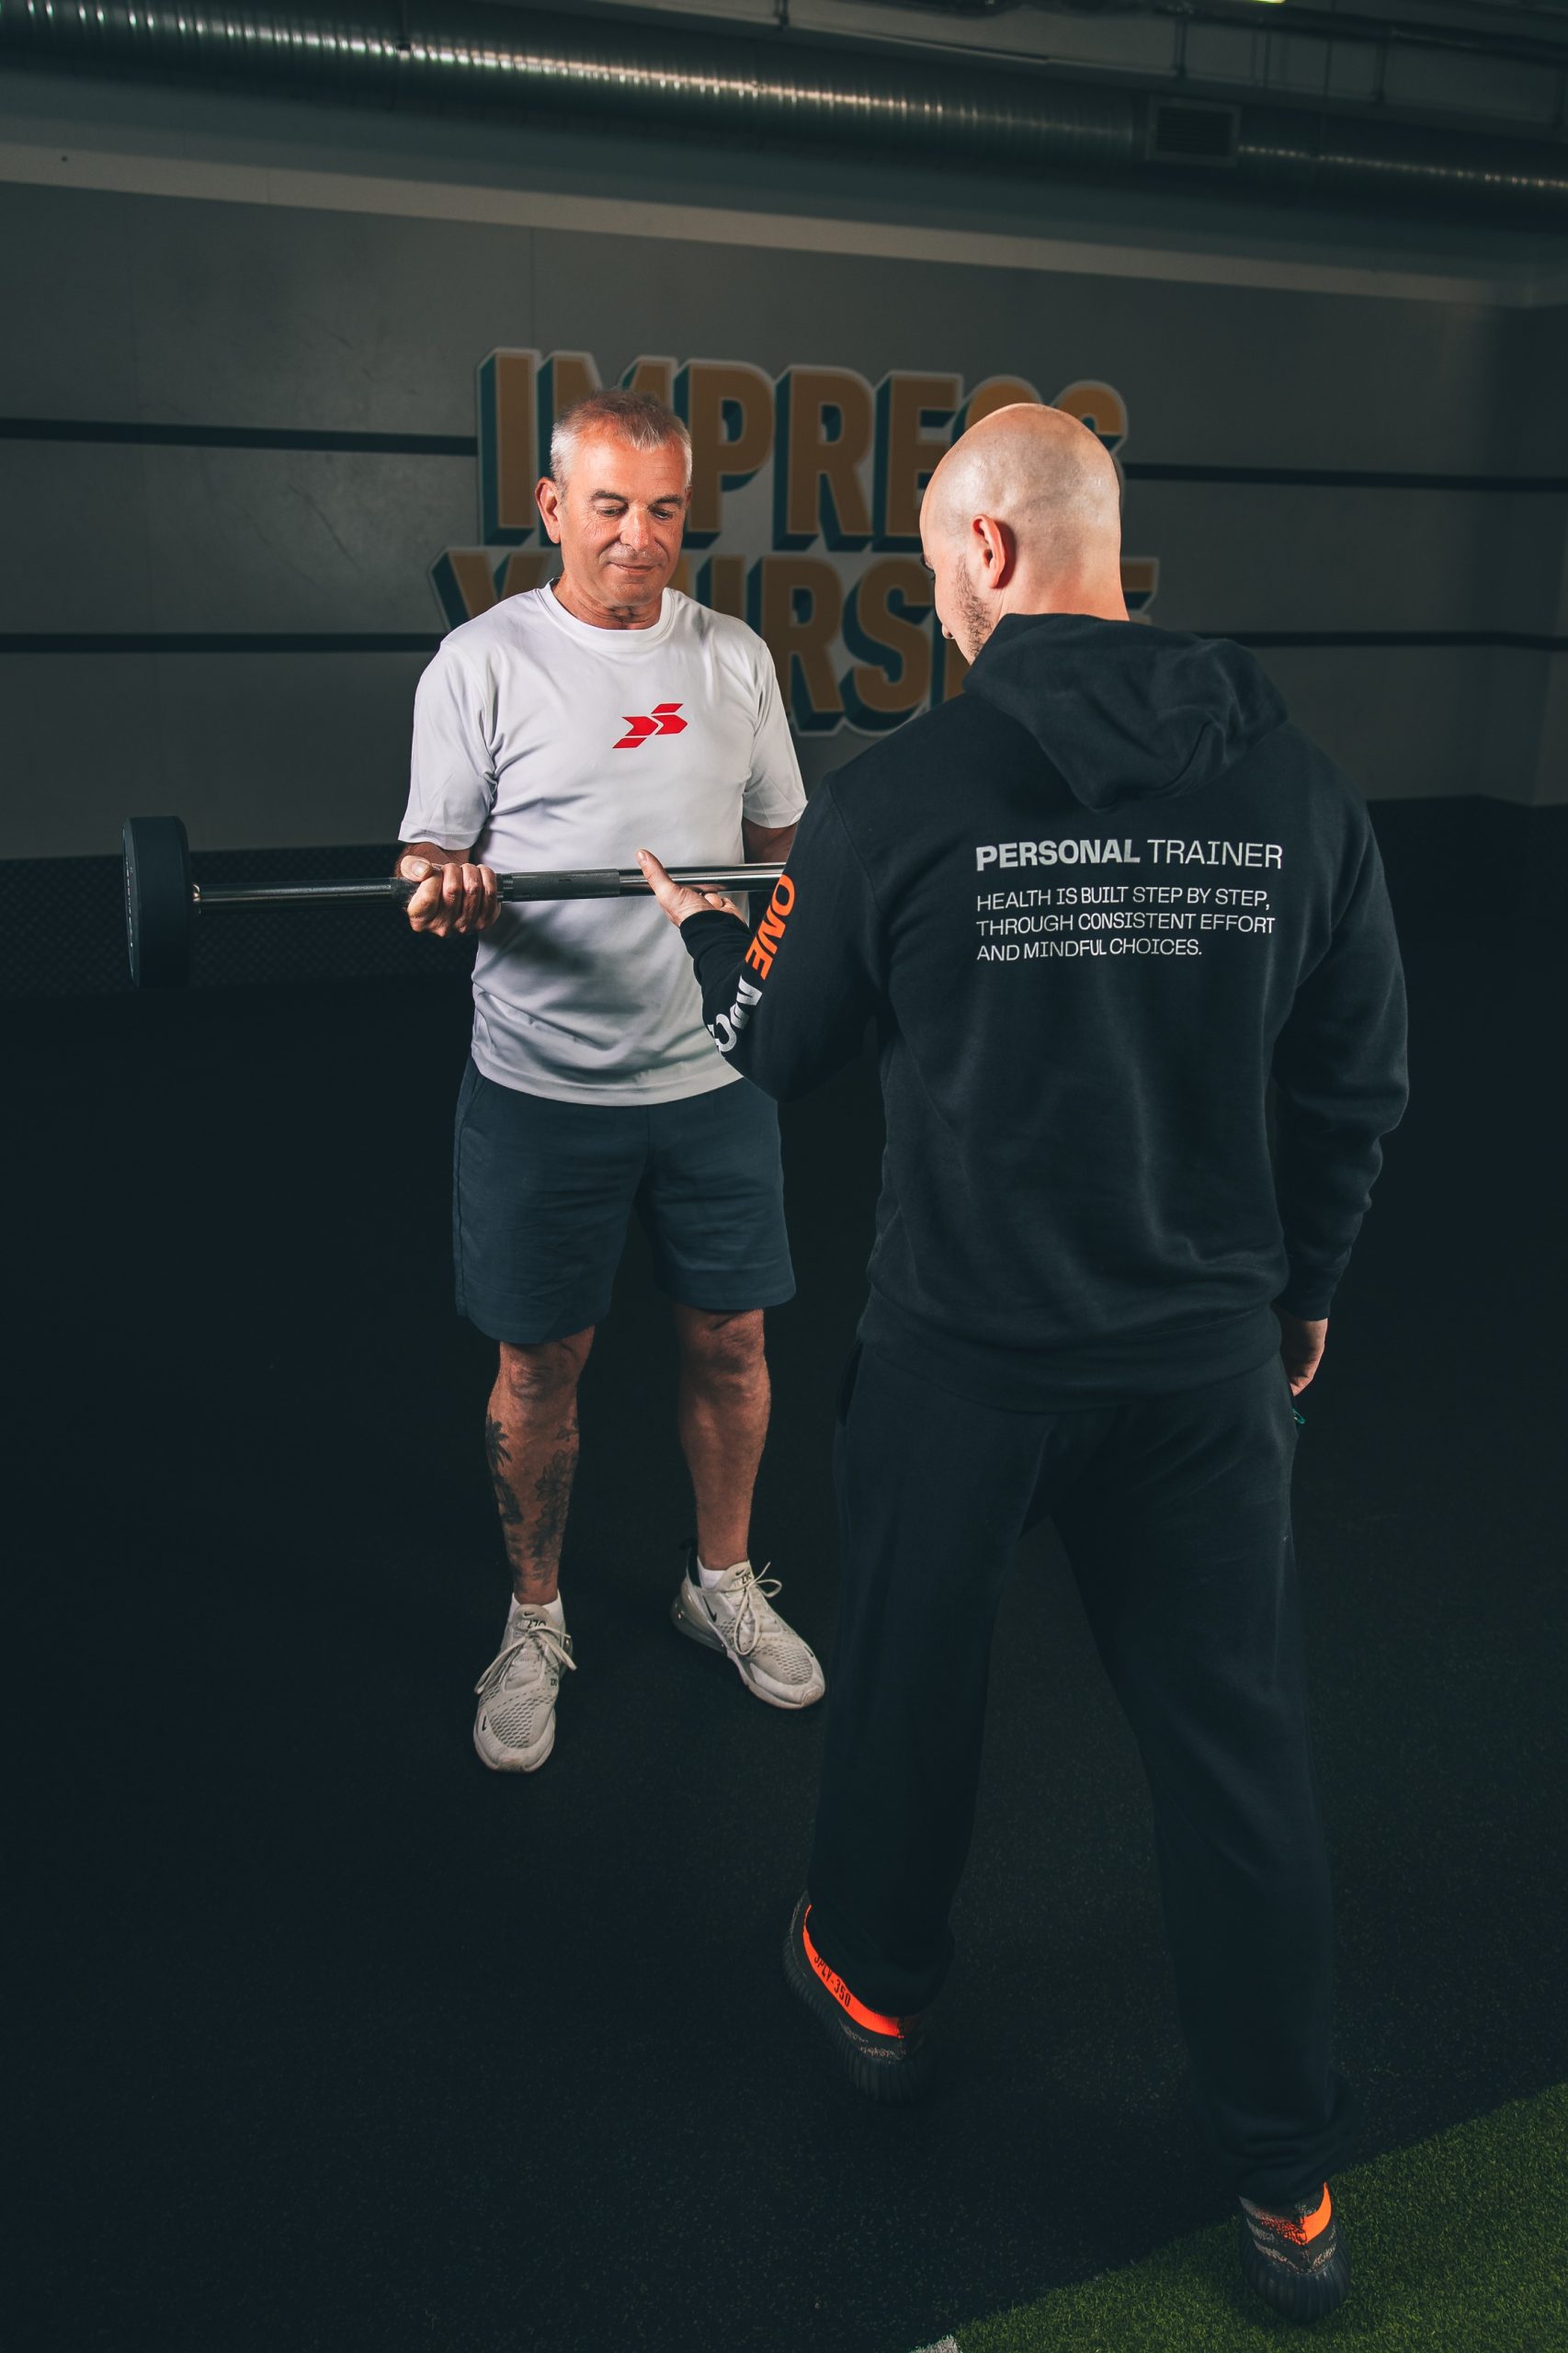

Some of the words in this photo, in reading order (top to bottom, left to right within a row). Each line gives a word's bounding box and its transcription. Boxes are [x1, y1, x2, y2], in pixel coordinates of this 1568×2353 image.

[479, 347, 1127, 551] IPRE
[976, 838, 1142, 871] PERSONAL
[1147, 838, 1283, 870] TRAINER
[977, 889, 1051, 912] HEALTH
[1056, 887, 1078, 905] IS
[1081, 886, 1130, 904] BUILT
[1132, 886, 1184, 904] STEP
[1187, 887, 1212, 904] BY
[1214, 888, 1270, 911] STEP,
[743, 873, 796, 981] ONE
[975, 914, 1074, 937] THROUGH
[1077, 912, 1198, 931] CONSISTENT
[1199, 914, 1277, 935] EFFORT
[976, 944, 1020, 962] AND
[1023, 938, 1108, 960] MINDFUL
[1108, 938, 1203, 956] CHOICES.
